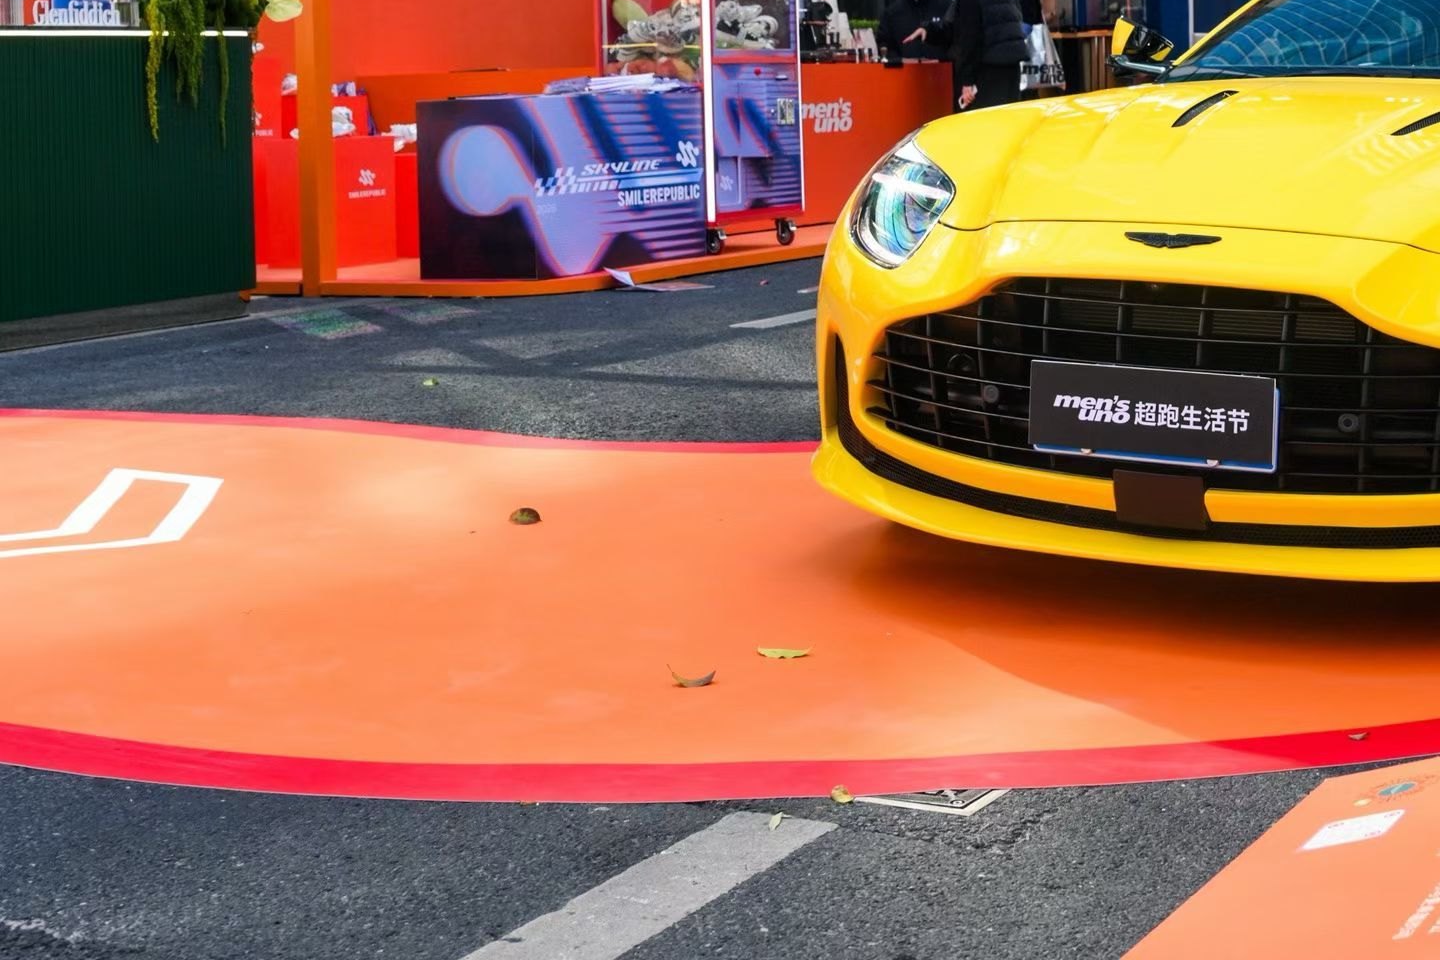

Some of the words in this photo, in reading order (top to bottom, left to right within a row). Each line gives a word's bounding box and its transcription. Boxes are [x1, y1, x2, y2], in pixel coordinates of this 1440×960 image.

[801, 97, 853, 121] men's
[814, 116, 853, 134] uno
[618, 184, 700, 207] SMILEREPUBLIC
[1053, 394, 1131, 412] men's
[1078, 408, 1131, 424] uno
[1133, 401, 1250, 434] 超跑生活节
